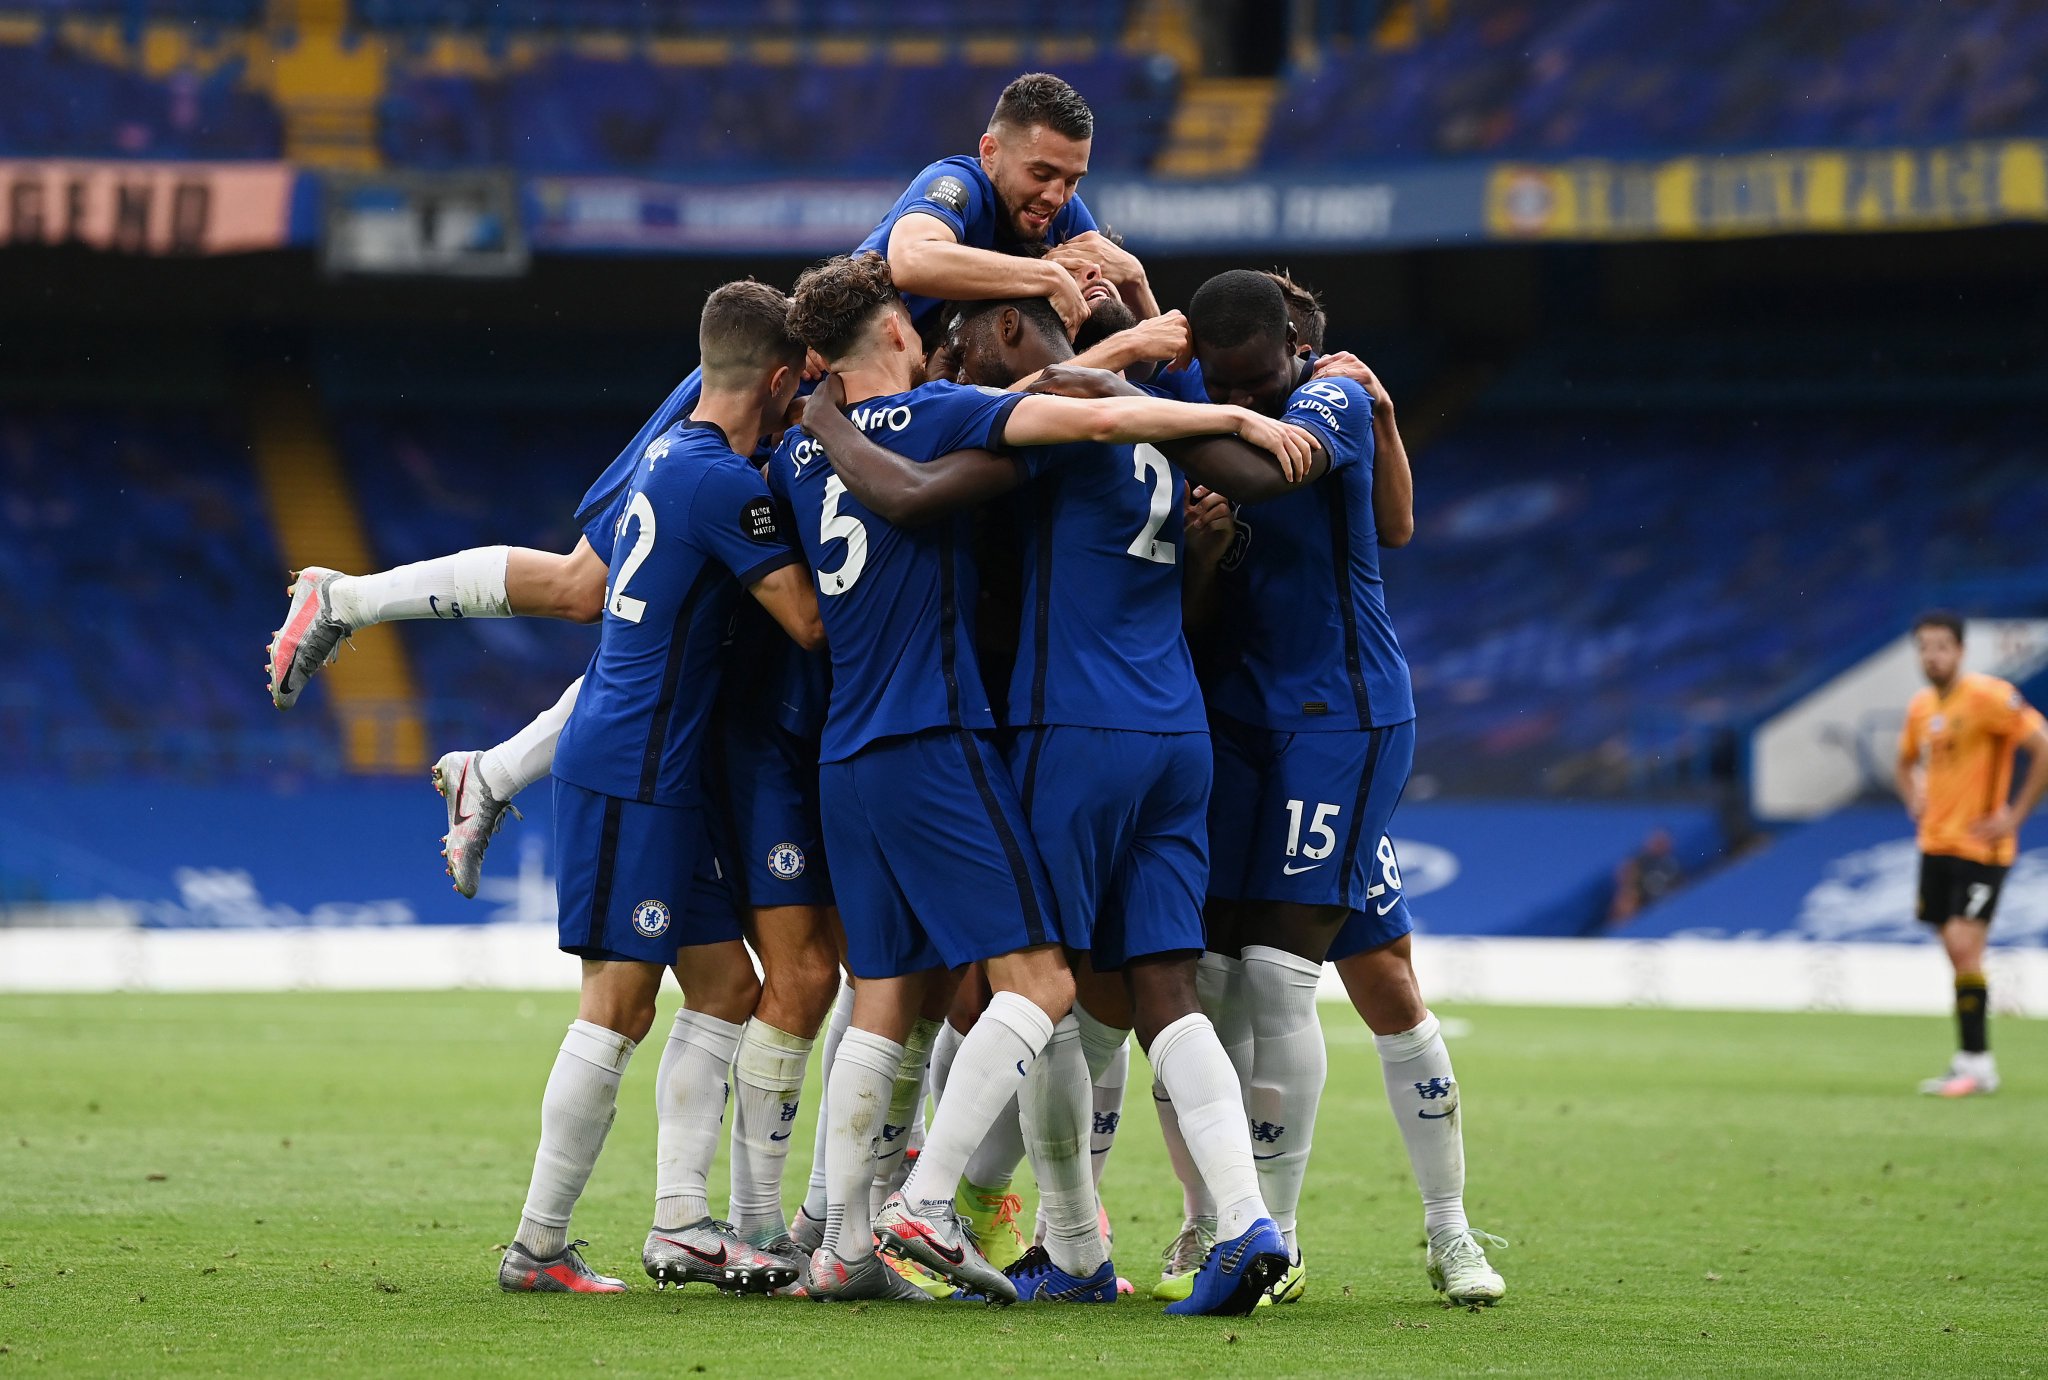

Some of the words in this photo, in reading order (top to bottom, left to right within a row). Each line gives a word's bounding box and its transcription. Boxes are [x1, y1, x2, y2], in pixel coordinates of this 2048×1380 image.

[1286, 399, 1340, 432] YUNDAI
[753, 516, 772, 527] LIVES
[1126, 442, 1177, 566] 2
[752, 525, 776, 536] MATTER
[816, 473, 868, 597] 5
[1285, 799, 1341, 860] 15
[1966, 883, 1992, 920] 7
